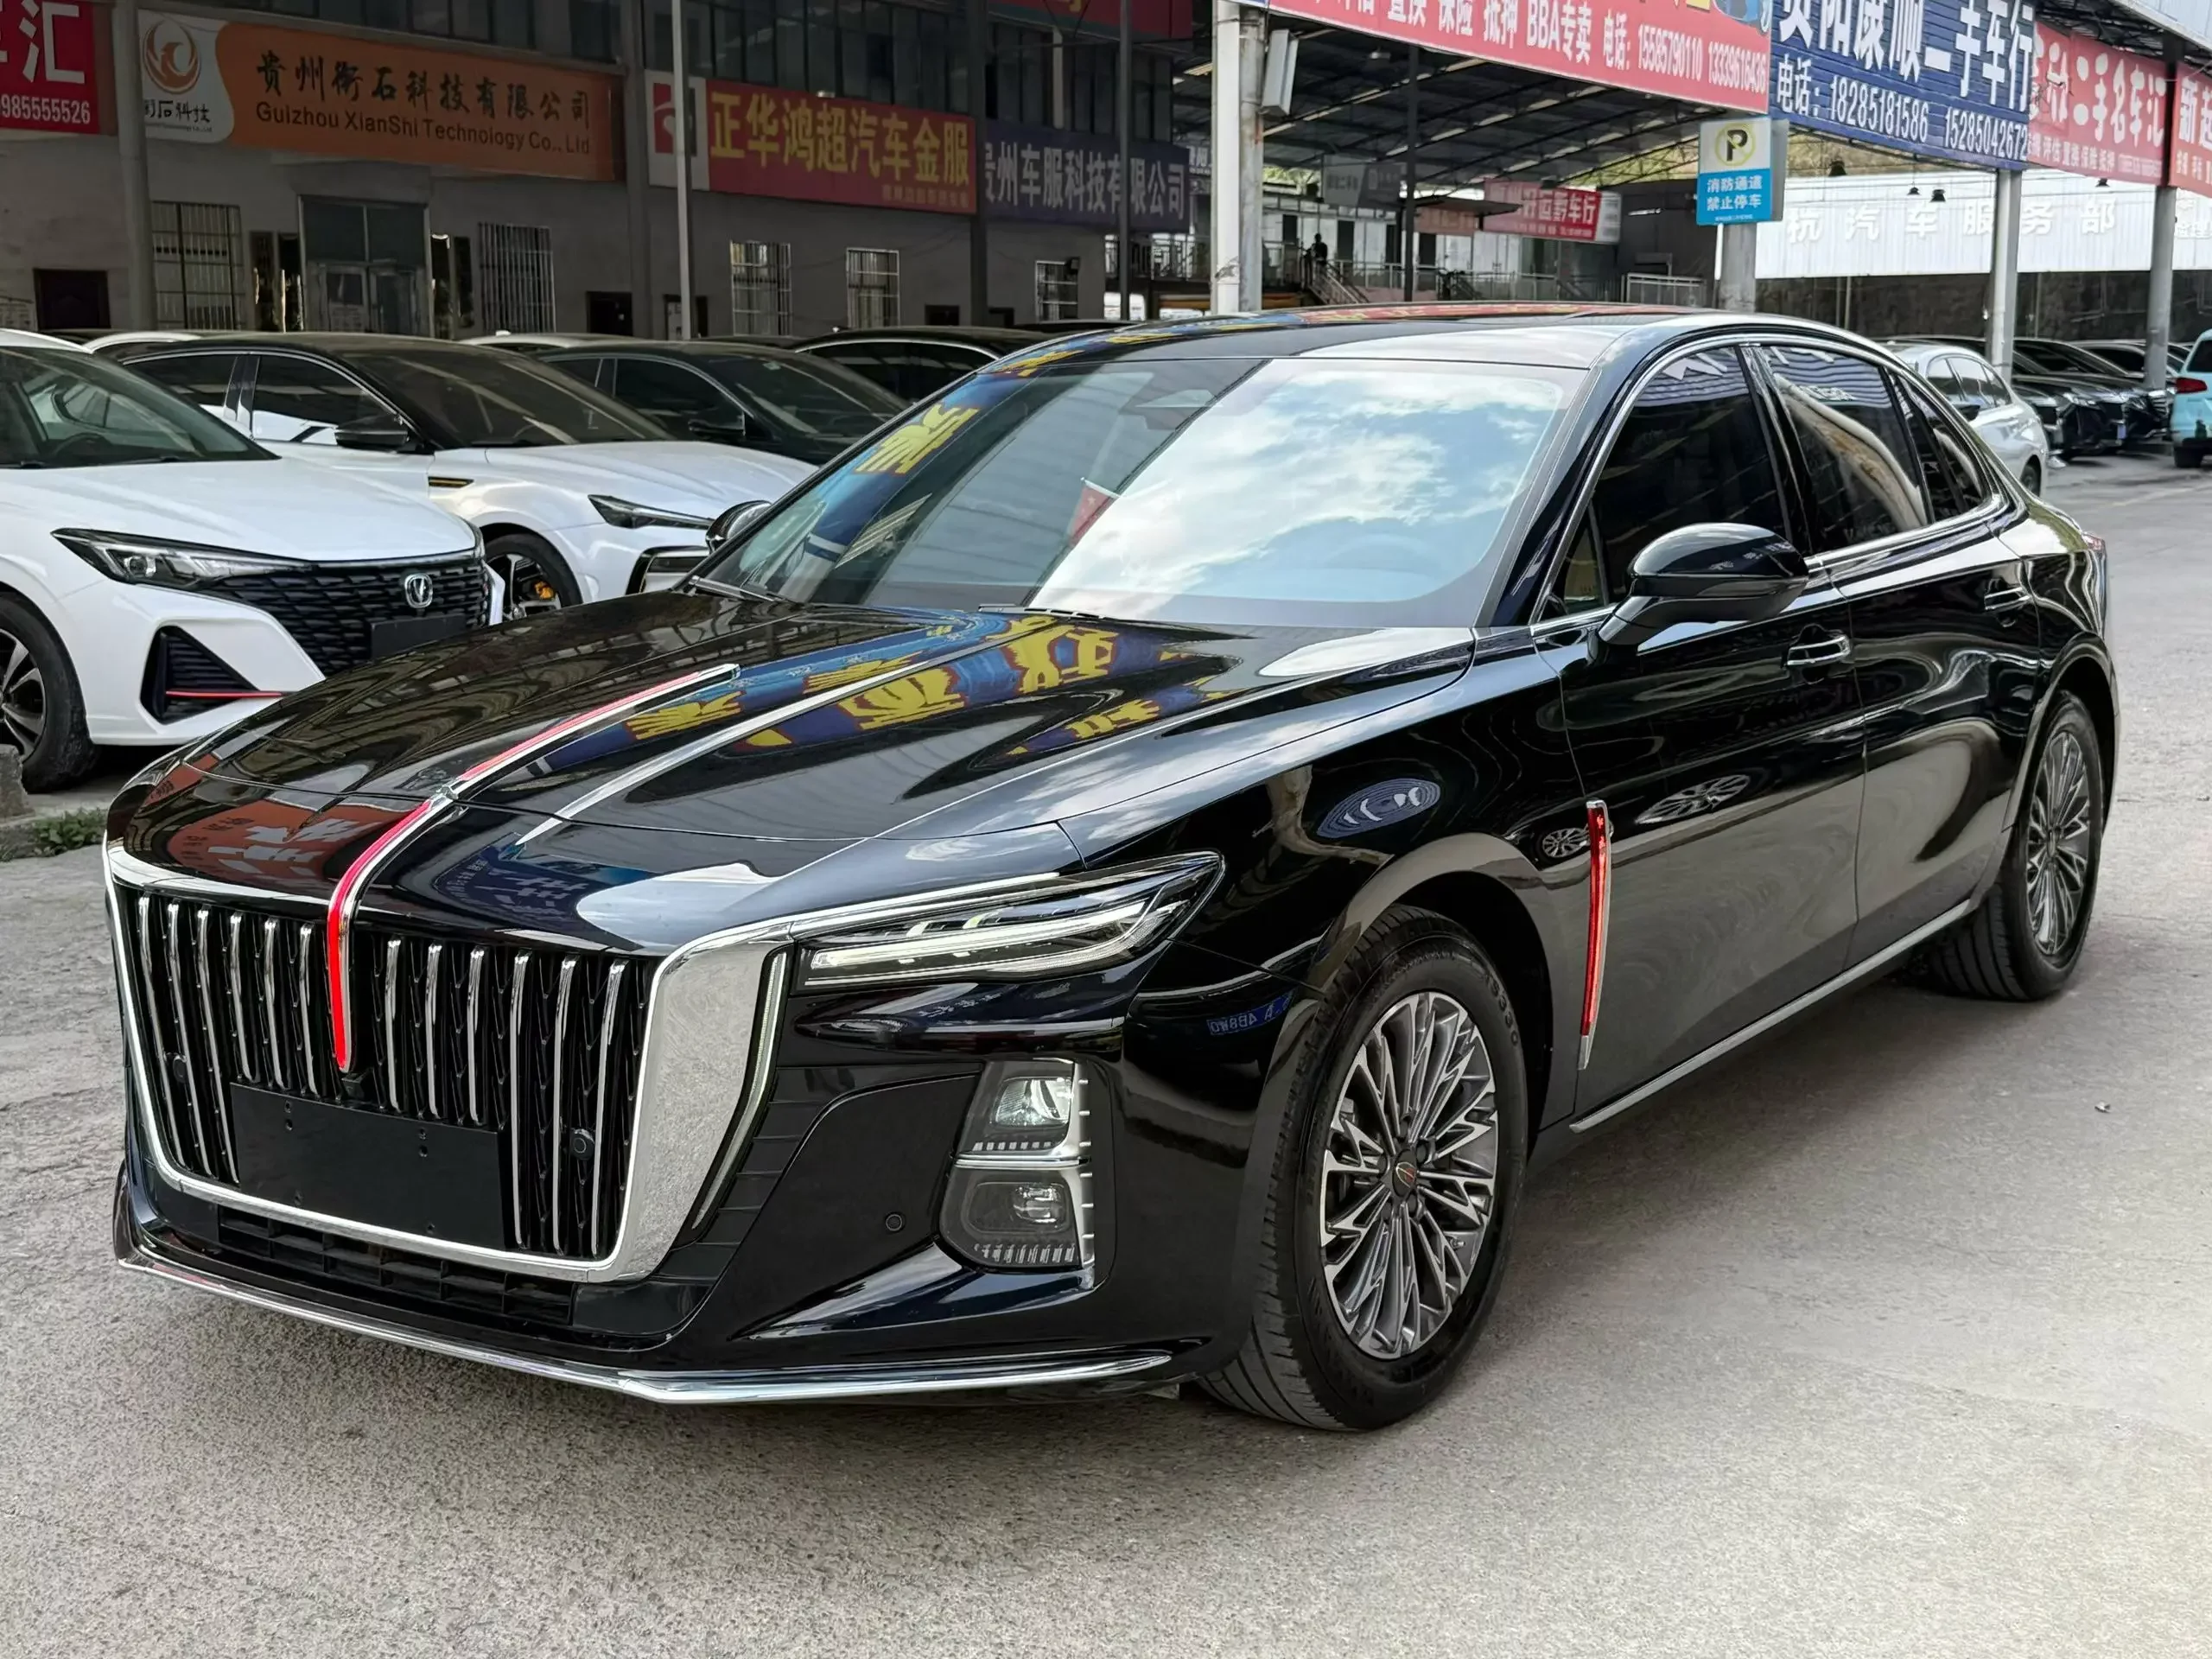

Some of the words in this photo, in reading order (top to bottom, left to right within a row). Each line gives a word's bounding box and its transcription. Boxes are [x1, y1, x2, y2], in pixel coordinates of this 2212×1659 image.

[0, 0, 86, 84] 汇
[1526, 0, 1592, 66] BBA专卖
[0, 92, 91, 125] 985555526
[256, 101, 340, 129] Guizhou
[345, 111, 419, 138] XianShi
[423, 118, 525, 152] Technology
[1829, 74, 1929, 143] 18285181586
[1944, 105, 2028, 162] 15285042672
[709, 91, 969, 187] 正华鸿超汽车金服
[1707, 175, 1763, 193] 消防通道
[1707, 194, 1762, 212] 禁止停车
